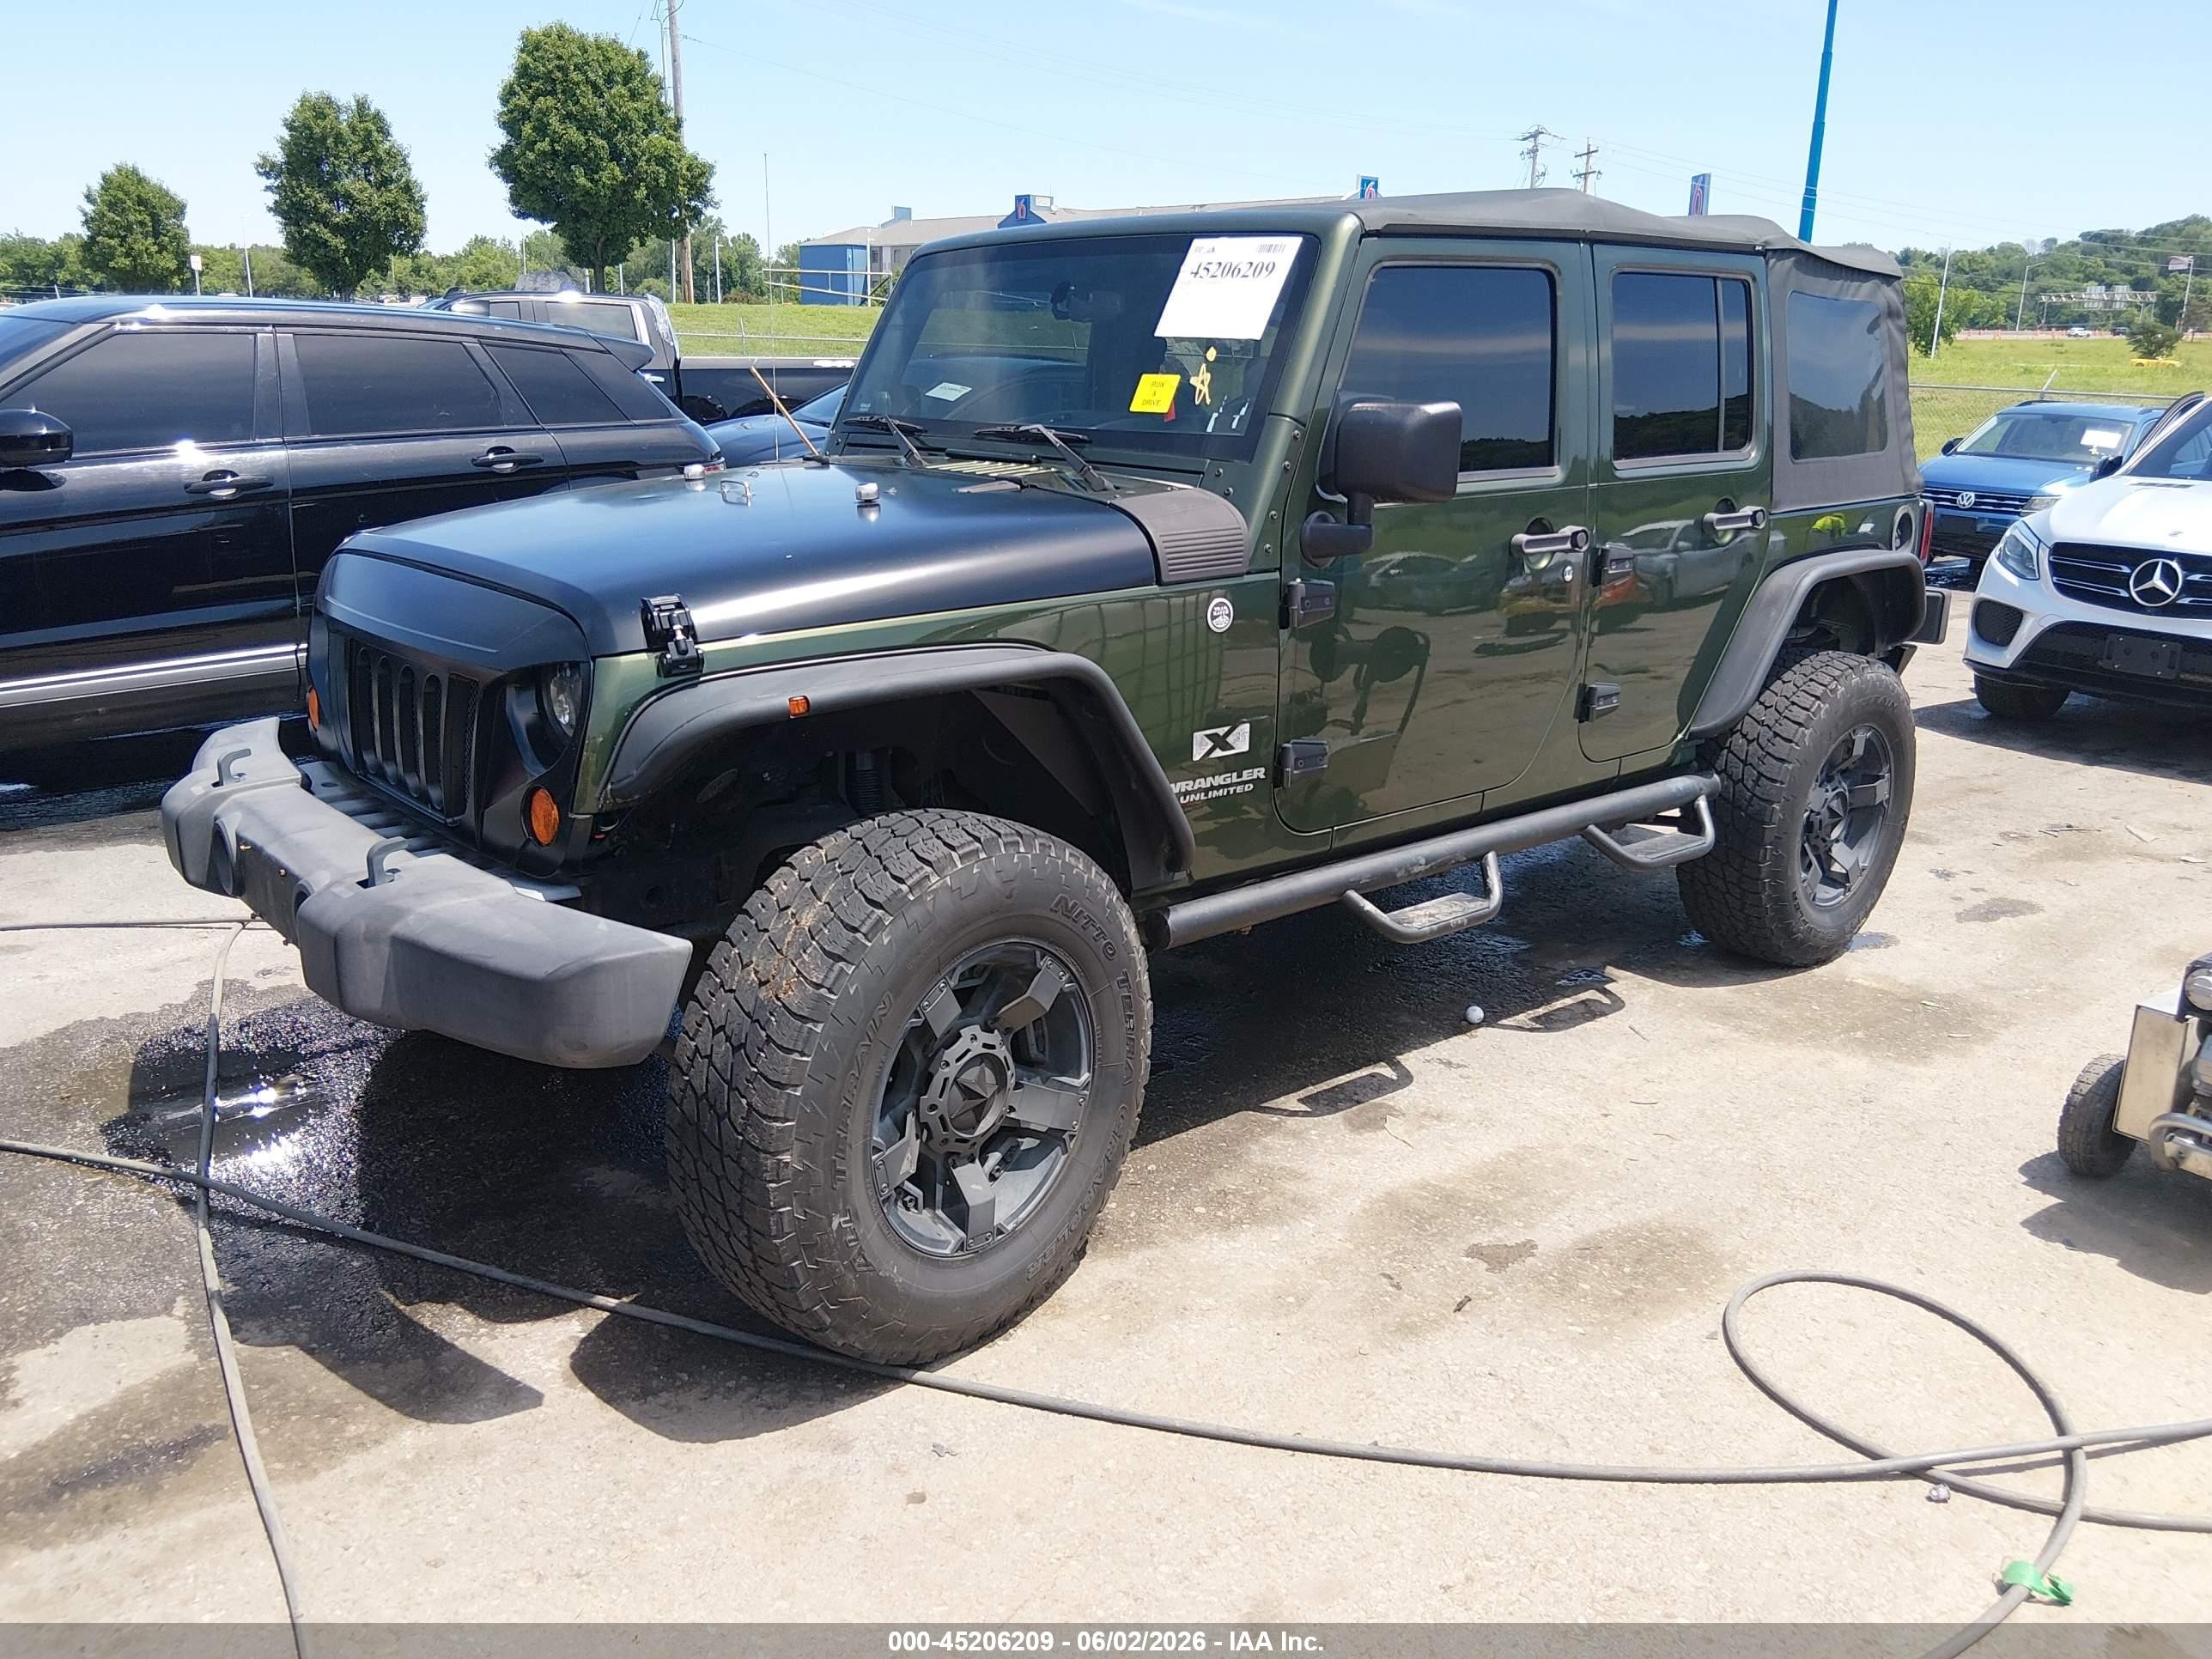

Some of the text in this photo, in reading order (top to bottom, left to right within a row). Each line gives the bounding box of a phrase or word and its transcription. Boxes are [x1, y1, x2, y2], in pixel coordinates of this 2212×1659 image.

[1692, 175, 1704, 216] 6
[1017, 198, 1027, 220] 6
[1190, 260, 1276, 279] 45206209
[1141, 398, 1162, 407] DRIVE
[1179, 783, 1254, 805] UNLIMITED
[1048, 893, 1117, 962] NITTO
[1115, 967, 1137, 1088] TERRA
